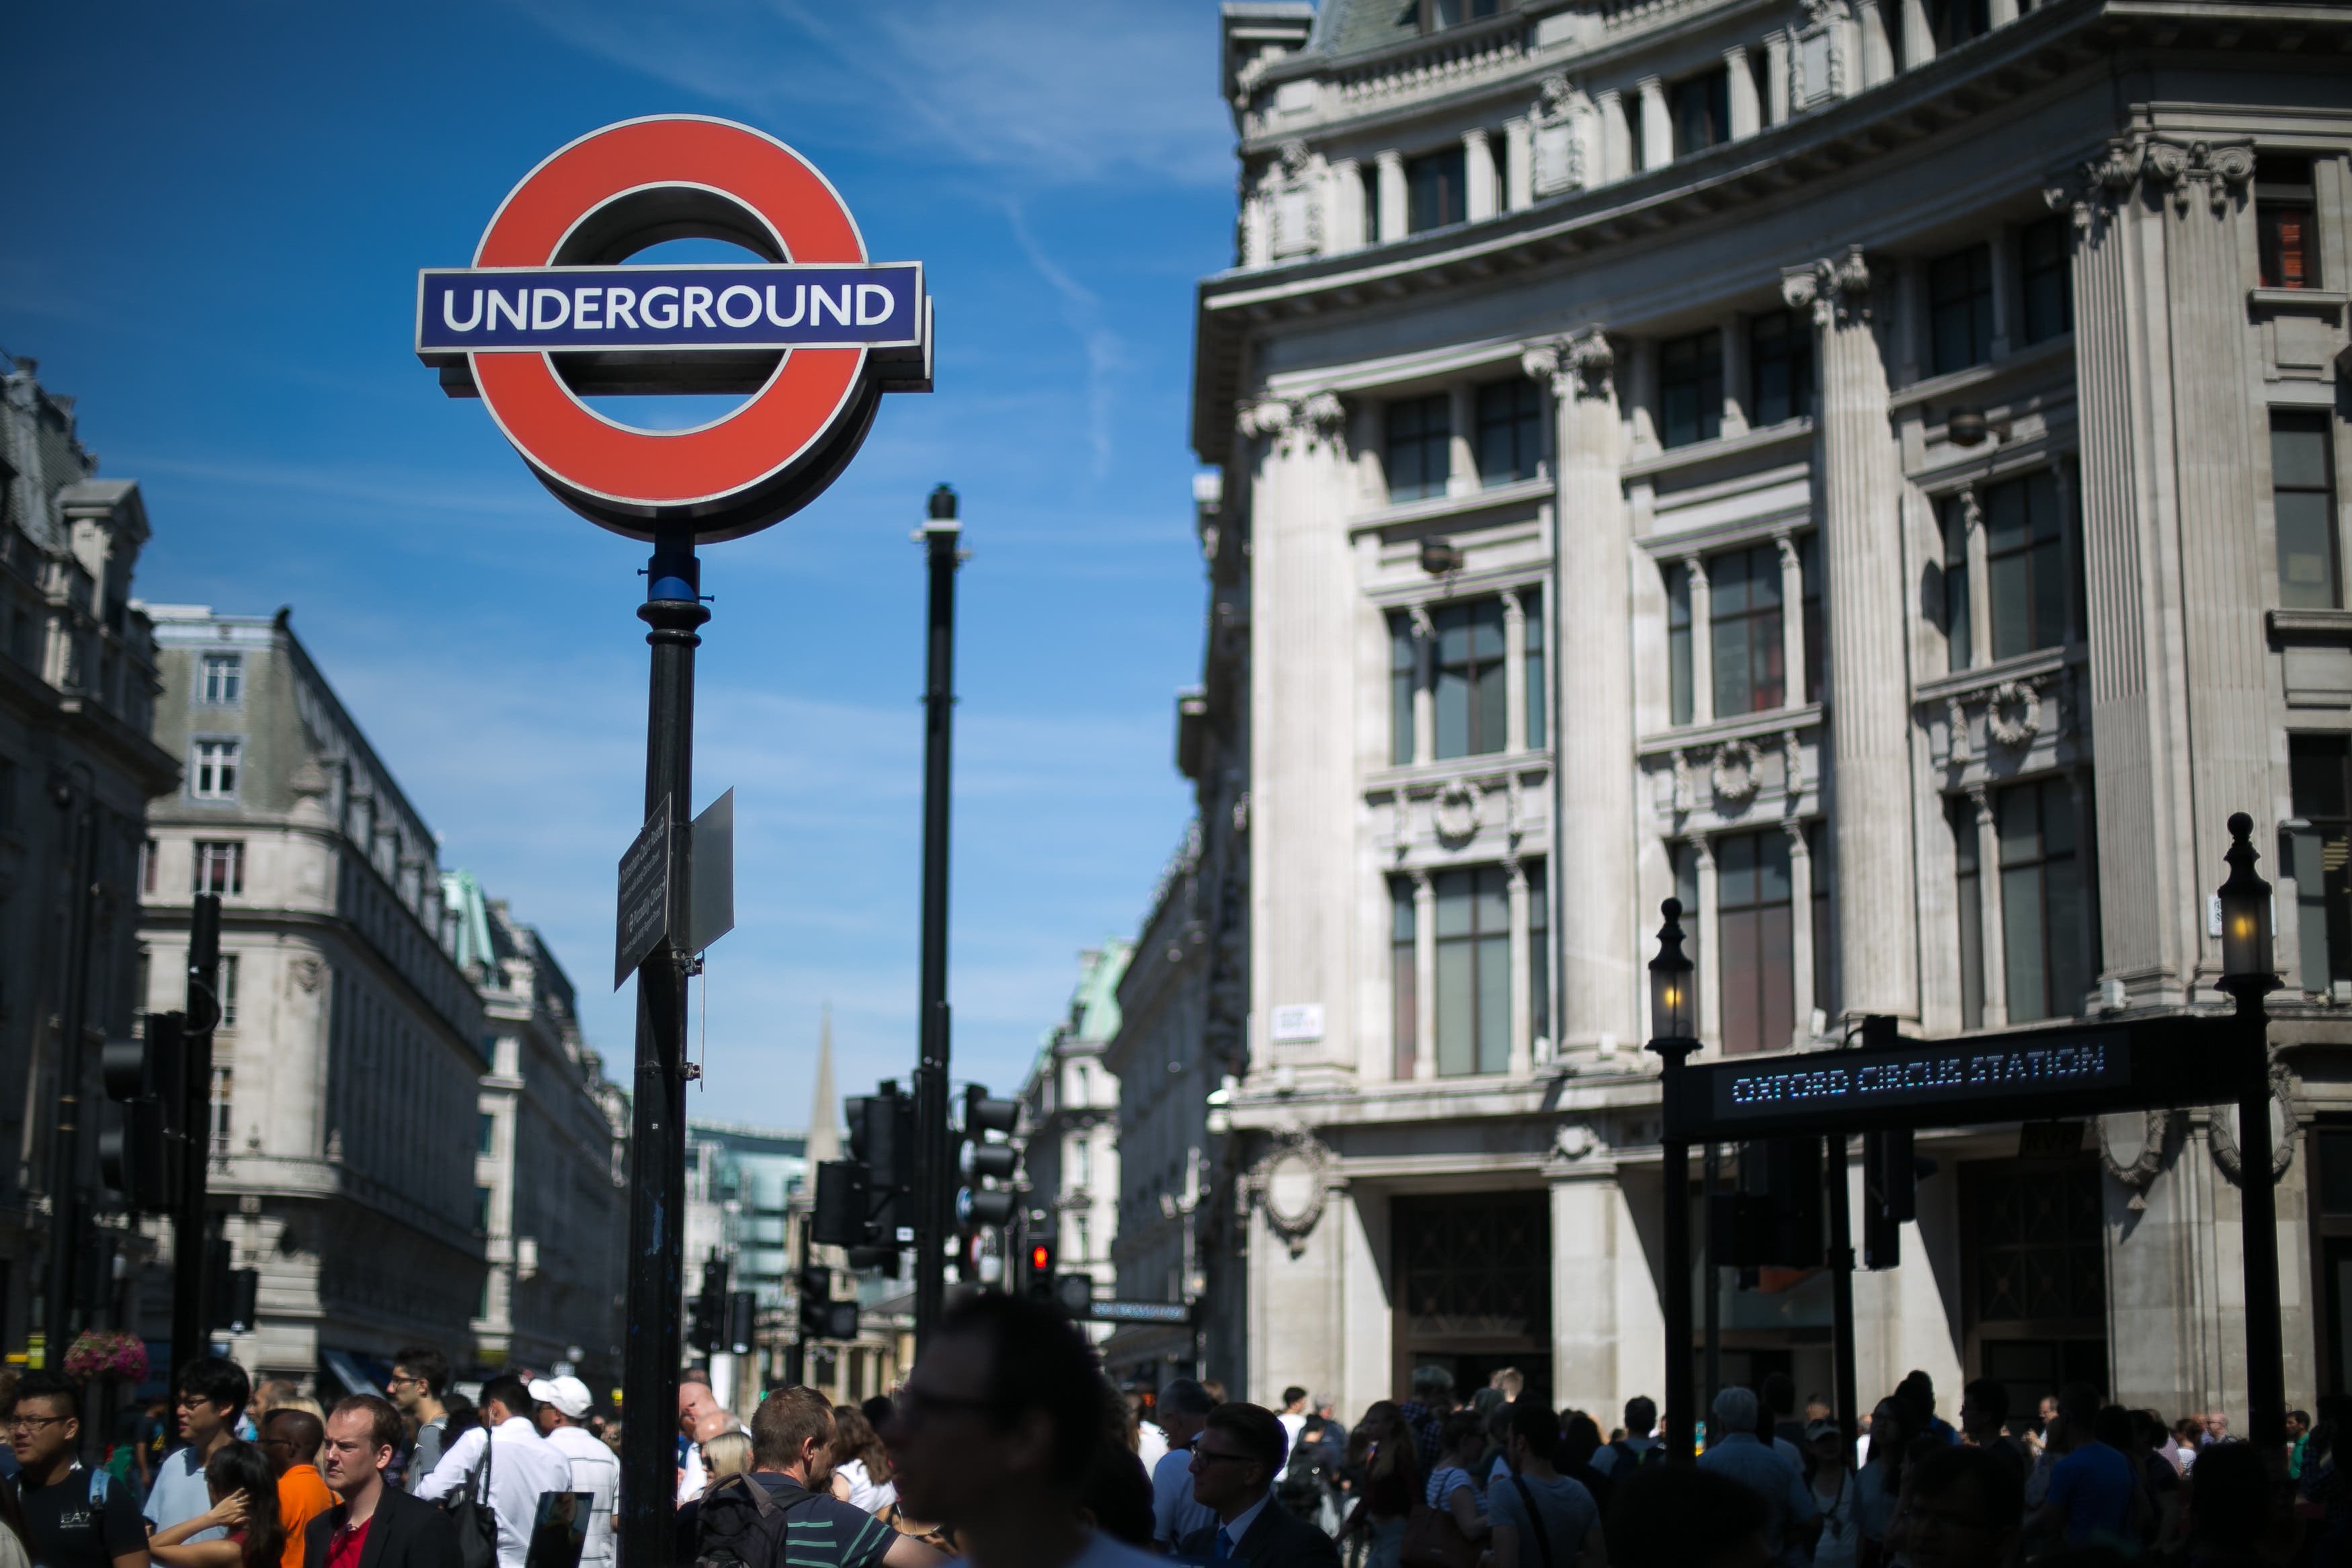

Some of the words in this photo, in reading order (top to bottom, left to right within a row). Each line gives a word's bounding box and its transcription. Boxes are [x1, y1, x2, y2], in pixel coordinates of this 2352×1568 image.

[444, 284, 895, 331] UNDERGROUND
[1733, 1069, 1849, 1102] OXFORD
[1857, 1059, 1962, 1091] CIRCUS
[1972, 1046, 2105, 1081] STATION
